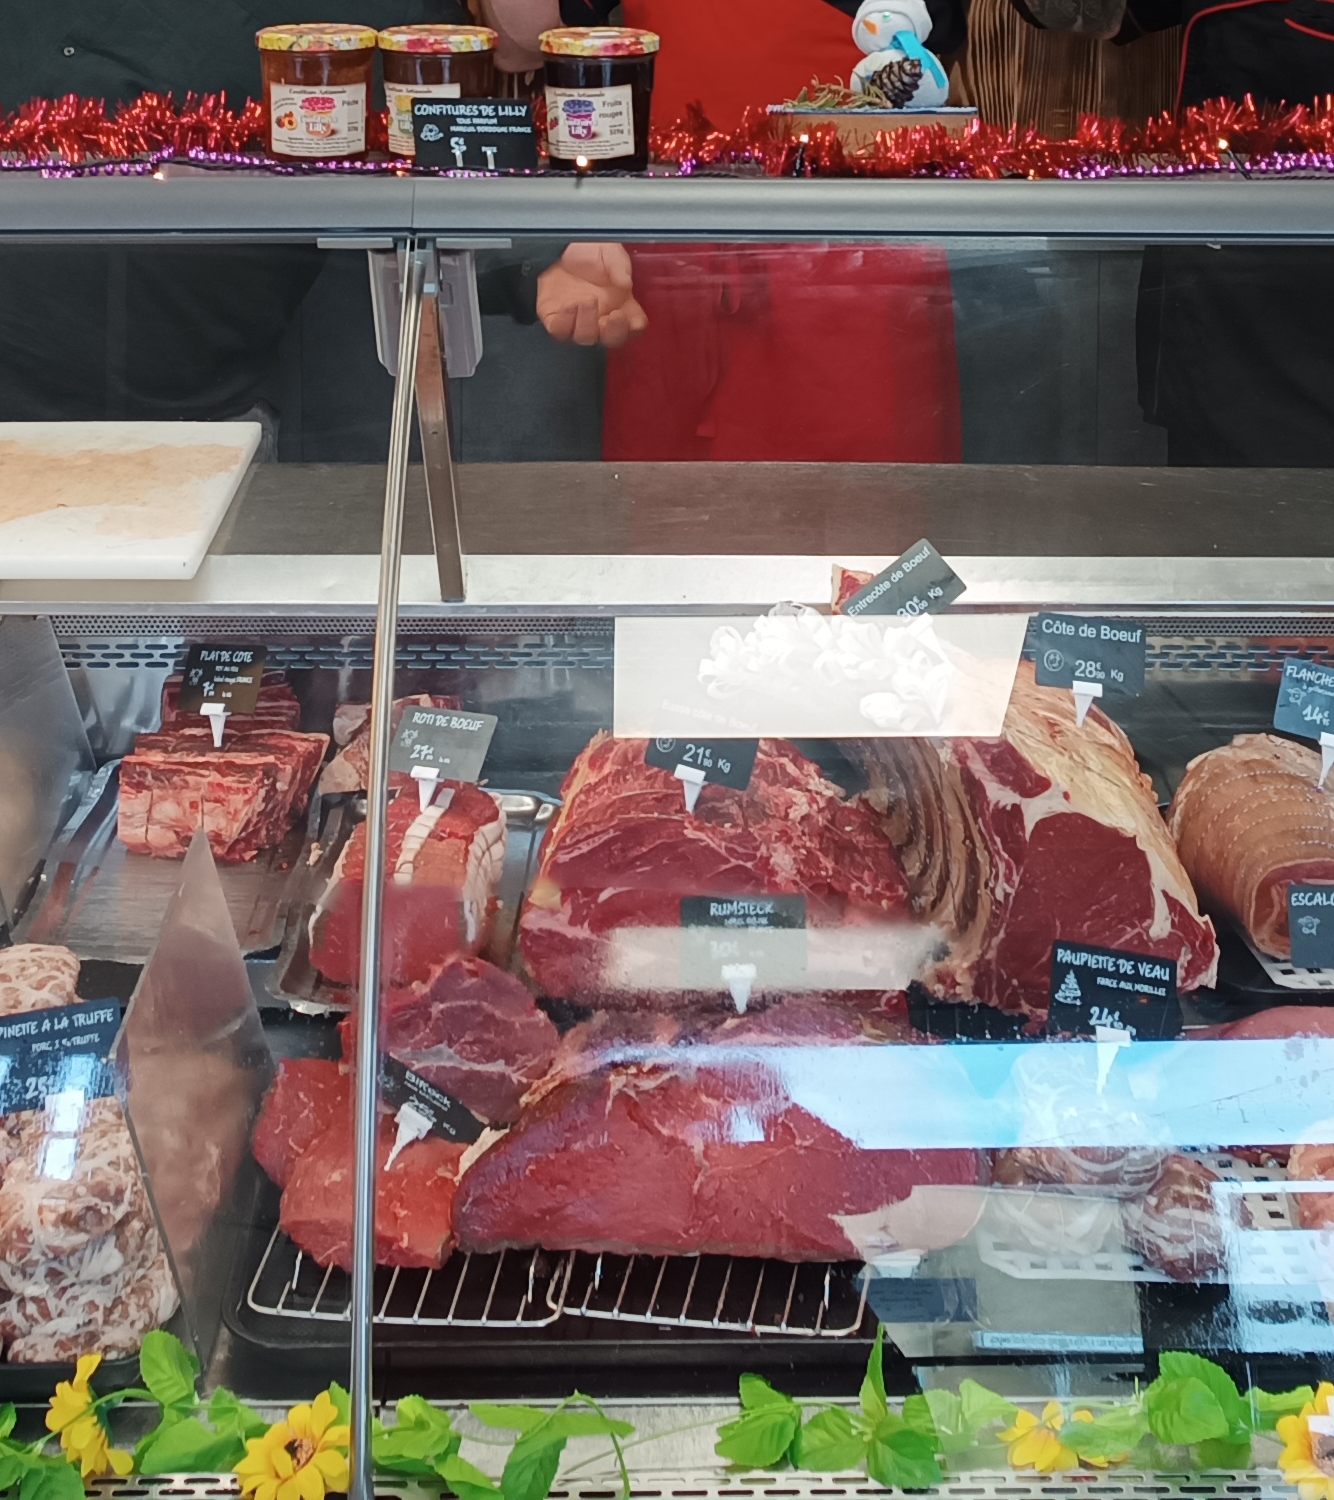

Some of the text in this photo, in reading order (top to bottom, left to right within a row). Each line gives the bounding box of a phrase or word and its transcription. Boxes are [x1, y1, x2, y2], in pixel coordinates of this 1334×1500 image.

[414, 104, 528, 117] CONFITURES DE LILLY
[602, 100, 623, 108] Fruits
[598, 111, 623, 119] rouges
[847, 545, 931, 618] Entrecôte de Boeuf
[928, 586, 944, 600] Kg
[1041, 619, 1143, 644] Côte de Boeuf
[199, 650, 254, 663] PLAT DE COTE
[1110, 668, 1124, 683] Kg
[411, 711, 485, 731] ROTI DE BOEUF
[717, 758, 732, 773] Kg
[709, 900, 775, 917] RUMSTECK
[1056, 948, 1170, 981] PAUPIETTE DE VEAU
[41, 1018, 52, 1031] A
[54, 1016, 70, 1031] LA
[72, 1007, 114, 1028] TRUFFE
[31, 1032, 101, 1053] PORC TRUFFE
